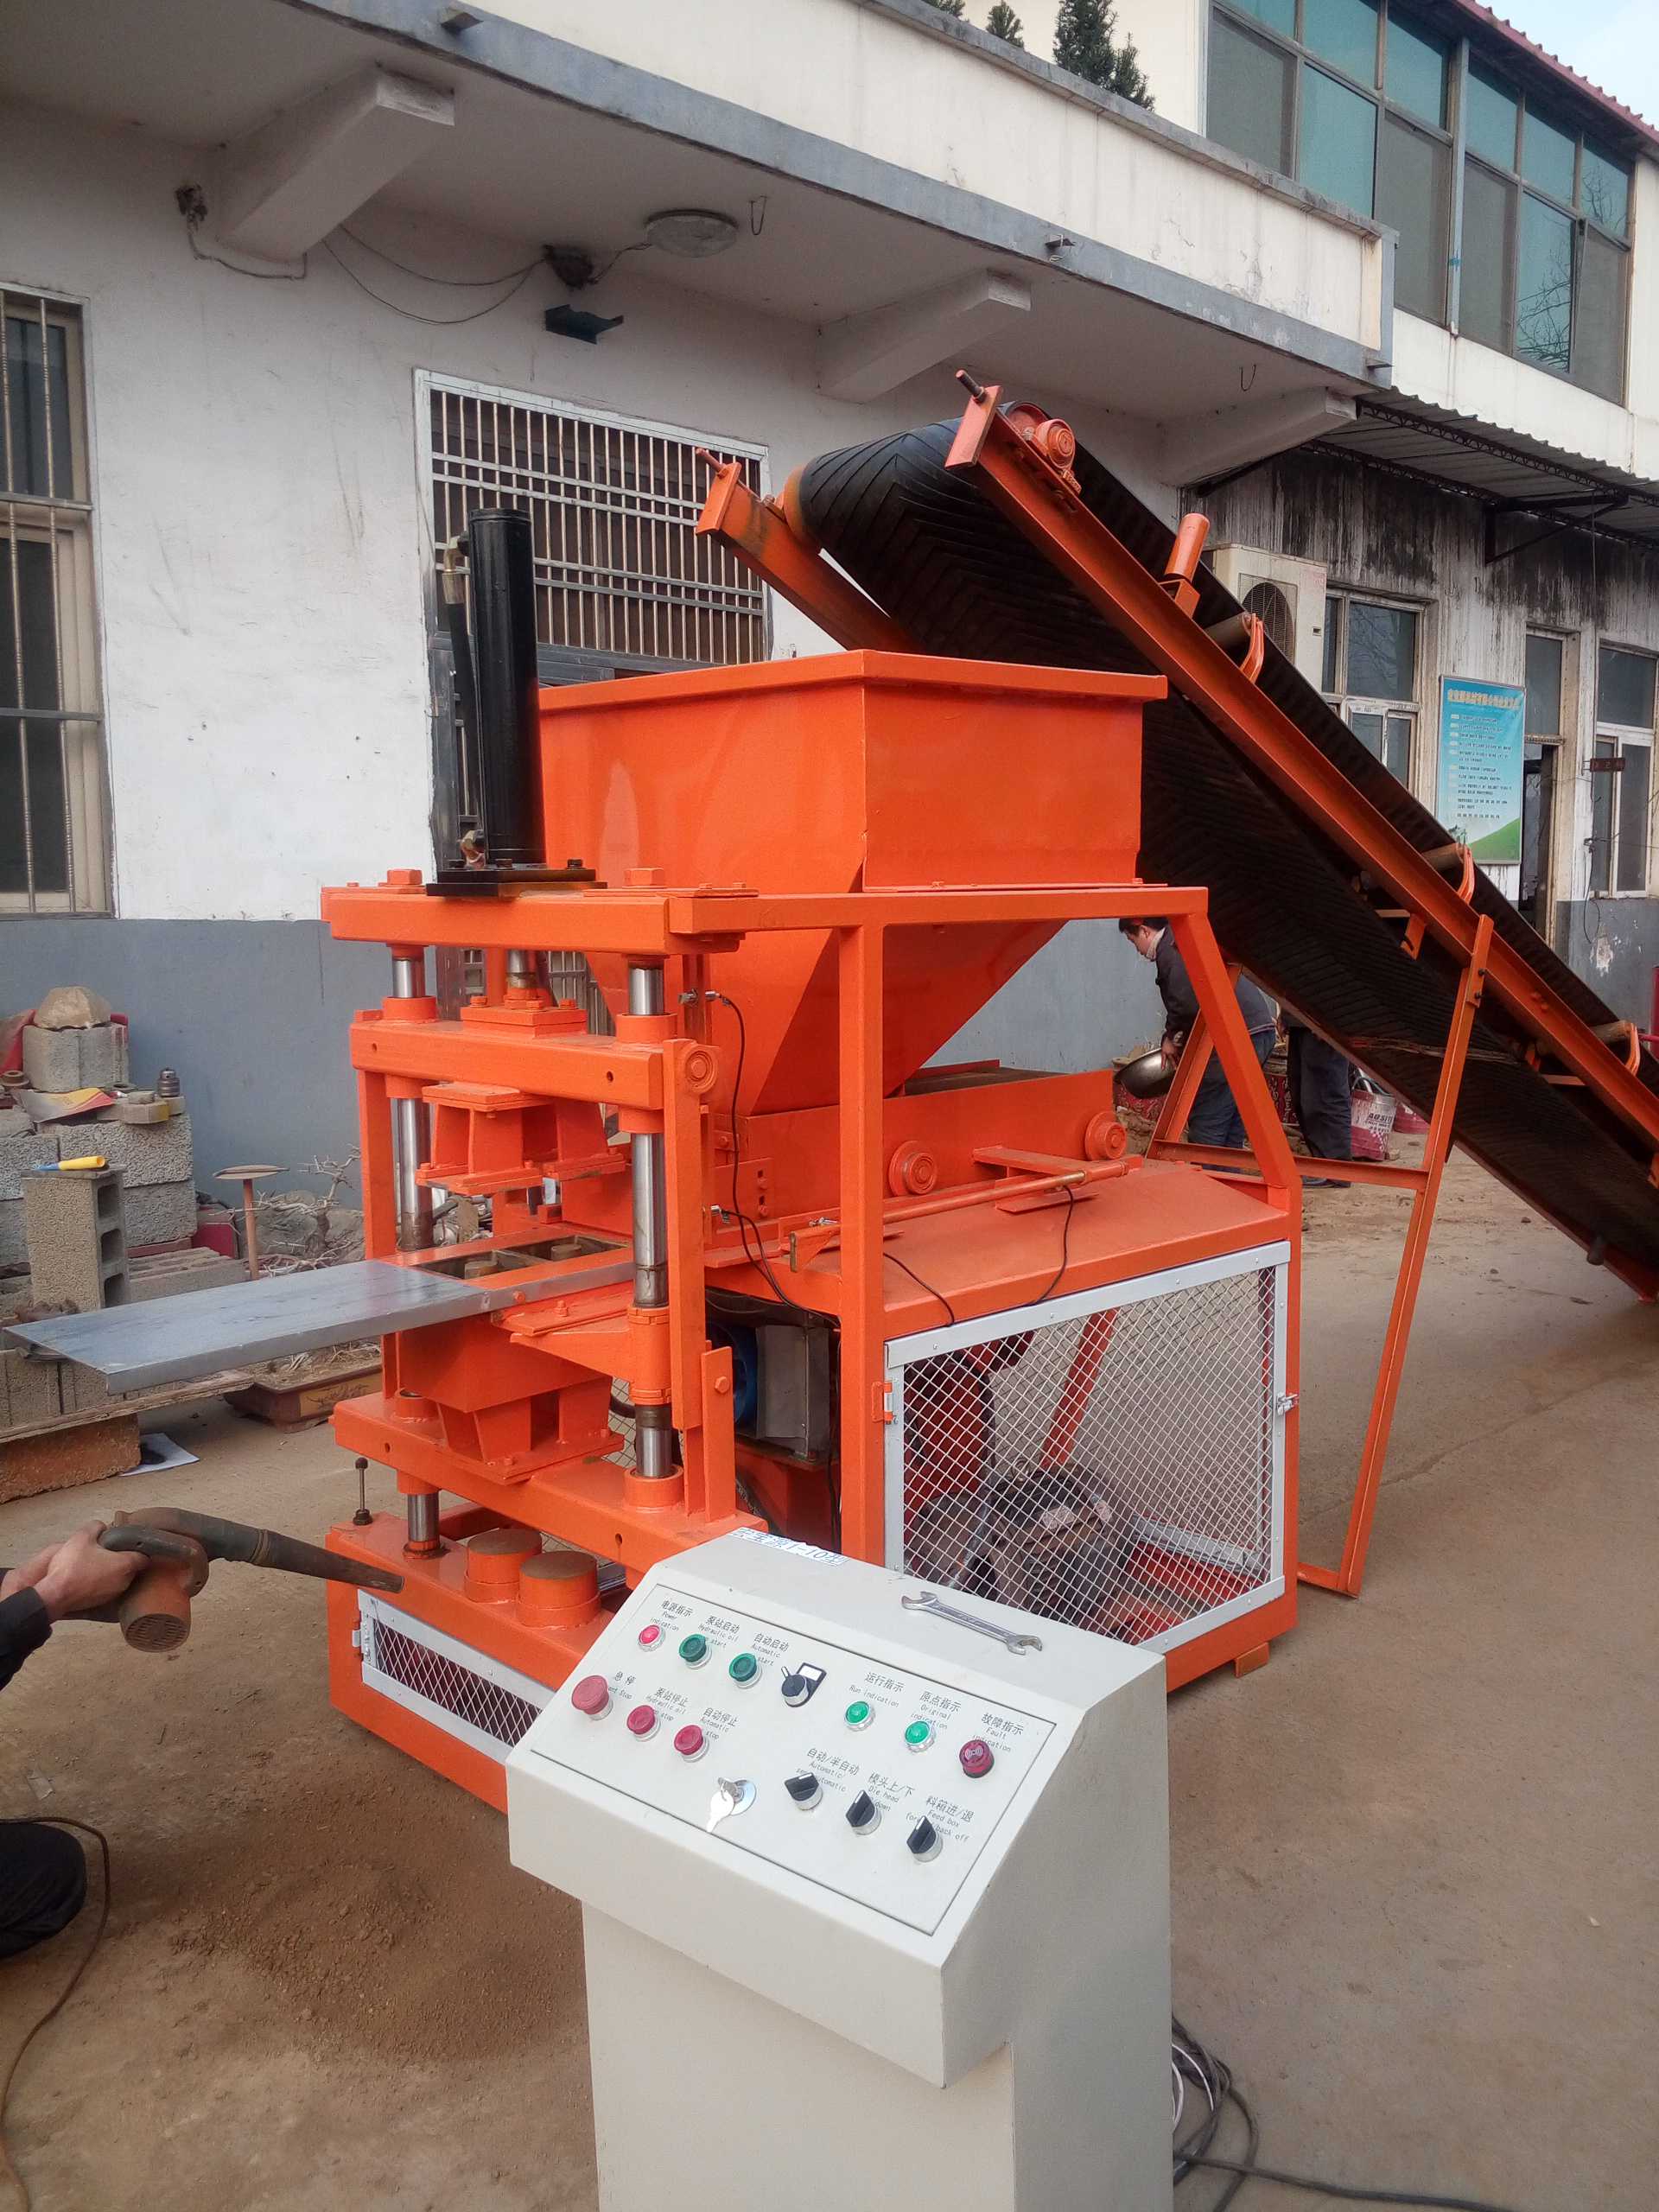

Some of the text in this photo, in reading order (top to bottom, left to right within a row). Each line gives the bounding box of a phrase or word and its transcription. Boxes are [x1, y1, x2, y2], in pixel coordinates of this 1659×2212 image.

[661, 1600, 694, 1618] 电源指示
[663, 1611, 677, 1620] Power
[698, 1624, 726, 1639] Hydraulic
[706, 1616, 741, 1634] 泵站启动
[752, 1643, 780, 1658] Automatic
[753, 1633, 789, 1652] 自动启动
[758, 1656, 774, 1666] start
[865, 1672, 906, 1692] 运行指示
[655, 1687, 689, 1707] 泵站停止
[849, 1684, 899, 1707] Run indication
[919, 1691, 961, 1712] 原点指示
[703, 1707, 738, 1726] 自动停止
[920, 1704, 951, 1720] Original
[700, 1717, 729, 1732] Automatic
[982, 1712, 1024, 1735] 故障指示
[986, 1727, 1006, 1740] Fault
[807, 1748, 860, 1776] 自动/半自动
[868, 1785, 899, 1803] Die head
[925, 1795, 974, 1822] 料箱进/退
[927, 1809, 960, 1827] Feed box
